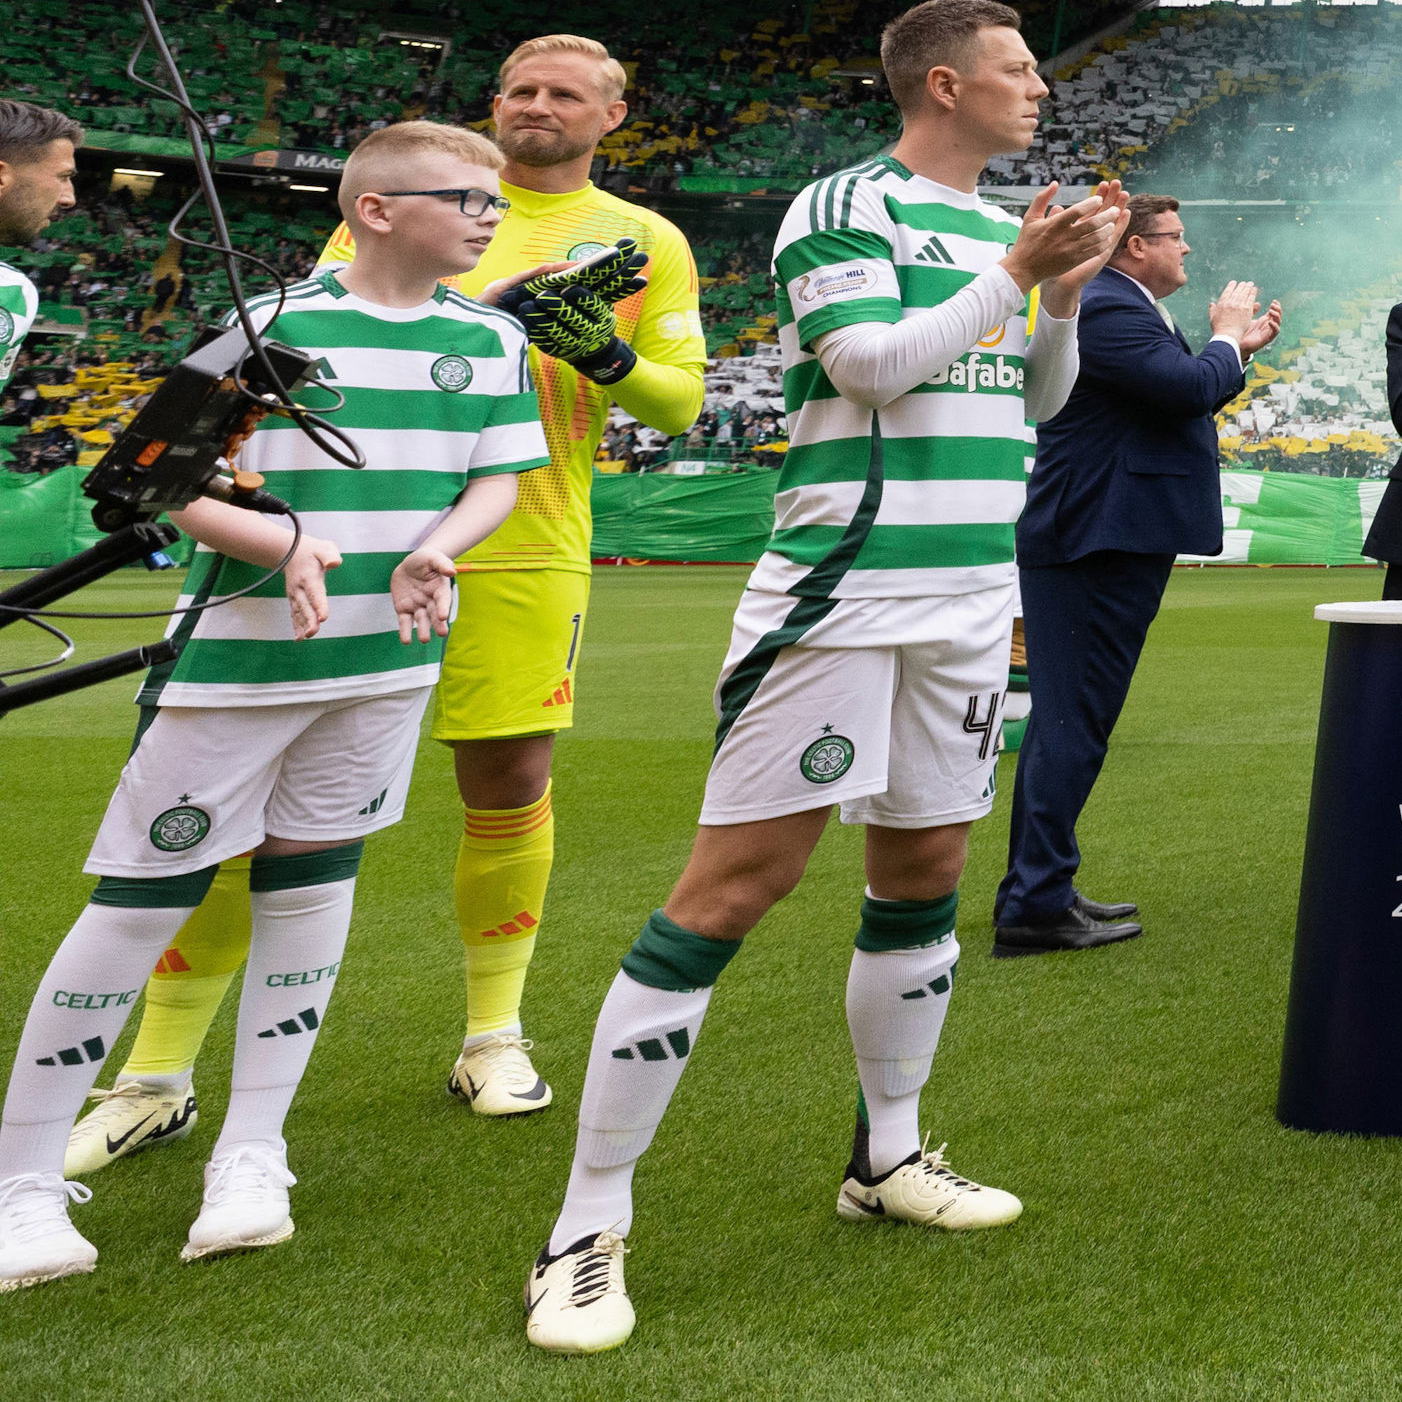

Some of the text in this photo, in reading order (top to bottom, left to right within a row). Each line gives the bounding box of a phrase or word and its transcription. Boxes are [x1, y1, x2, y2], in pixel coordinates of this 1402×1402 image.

[294, 154, 343, 170] MAG
[846, 269, 866, 279] HILL
[962, 692, 1005, 761] 4
[53, 990, 137, 1009] CELTIC
